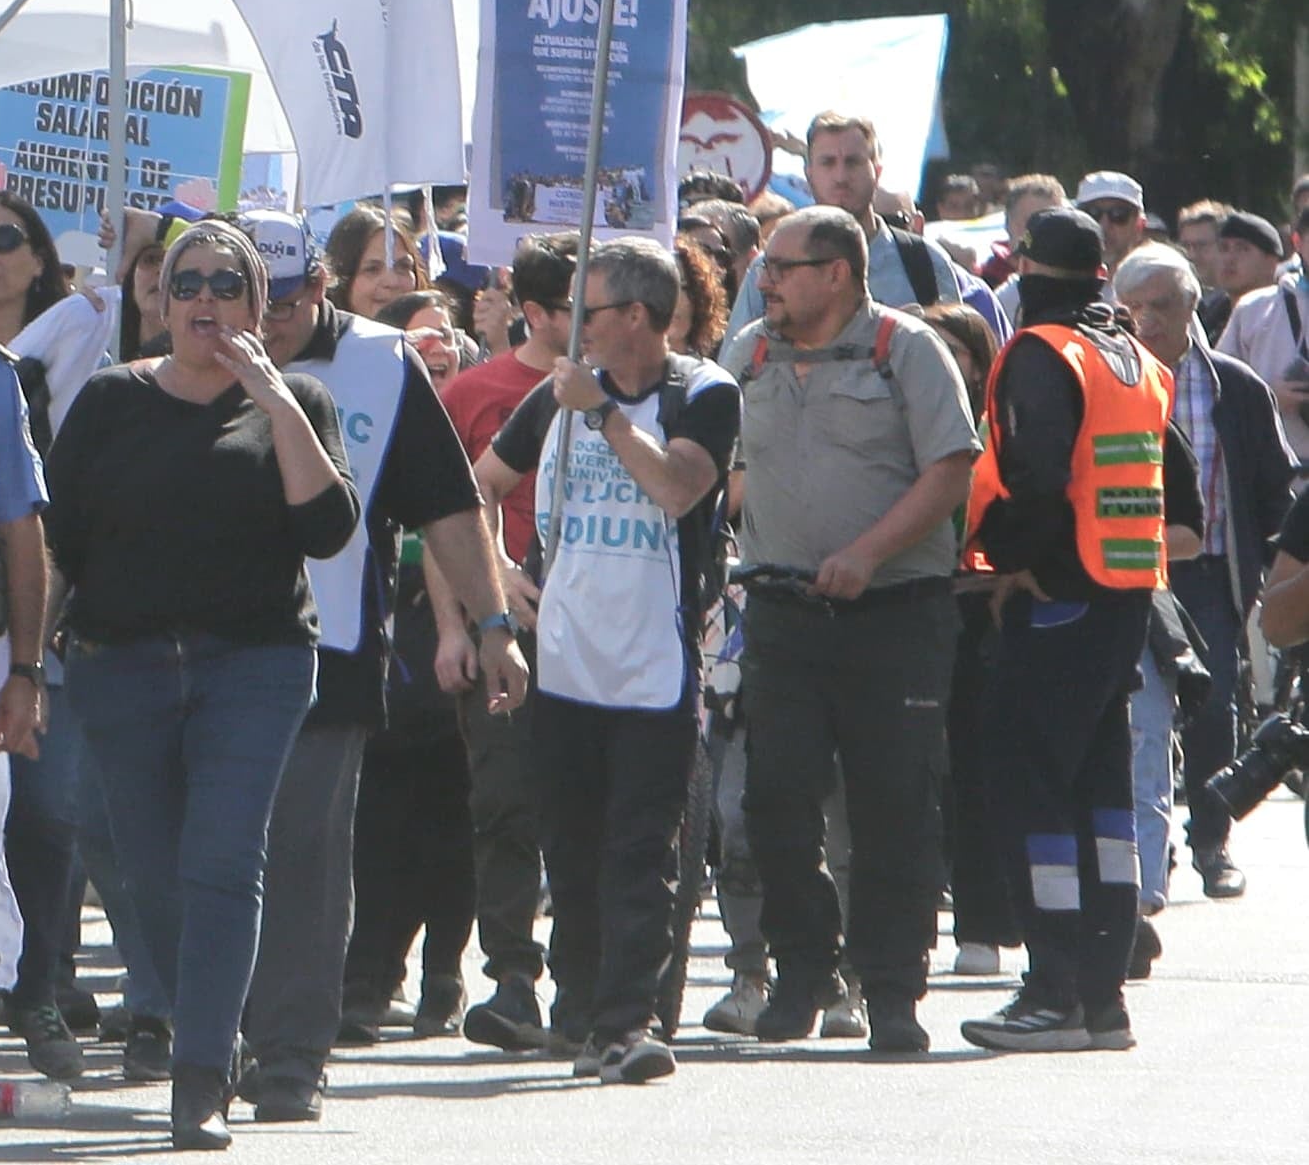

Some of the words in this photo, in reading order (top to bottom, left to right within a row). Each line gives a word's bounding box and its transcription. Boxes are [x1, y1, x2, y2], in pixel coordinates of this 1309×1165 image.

[36, 100, 150, 147] SALARAL
[14, 139, 129, 184] AUMENT
[140, 158, 171, 191] DE
